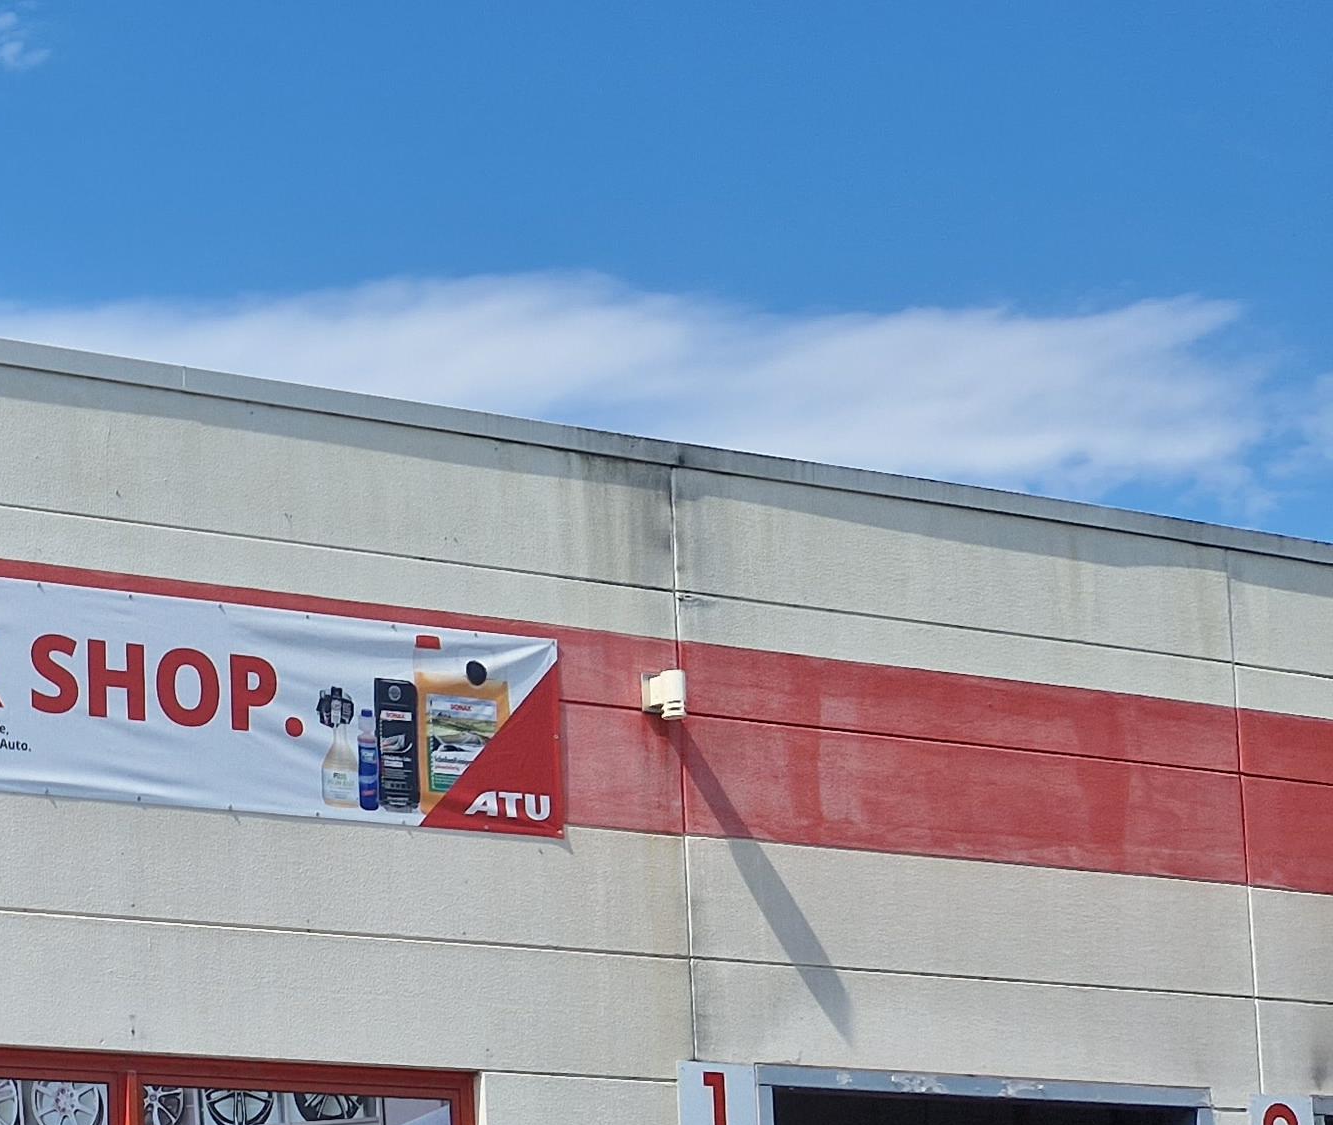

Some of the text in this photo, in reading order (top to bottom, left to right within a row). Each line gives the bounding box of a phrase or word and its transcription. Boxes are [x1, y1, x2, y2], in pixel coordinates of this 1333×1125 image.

[30, 633, 304, 738] SHOP.
[0, 738, 33, 753] Auto.
[464, 791, 551, 821] ATU
